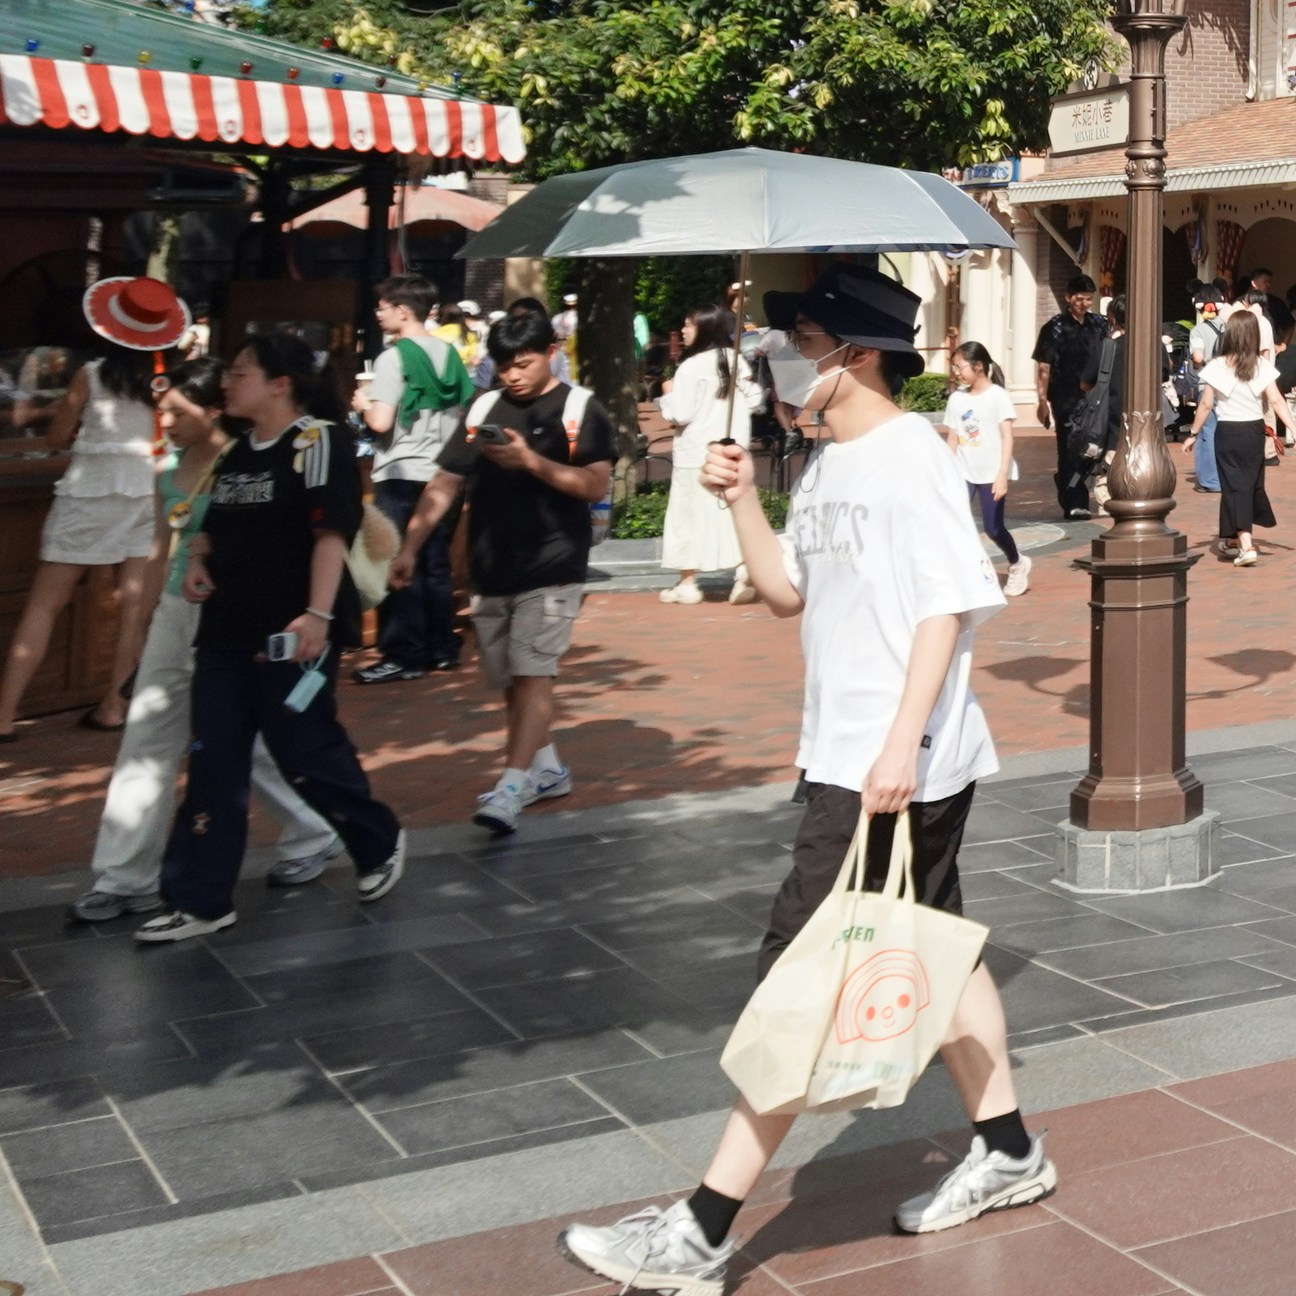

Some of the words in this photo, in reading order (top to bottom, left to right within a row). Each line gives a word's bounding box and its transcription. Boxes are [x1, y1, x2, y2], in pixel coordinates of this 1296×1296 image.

[1071, 99, 1113, 129] 米妮小巷
[1096, 127, 1110, 140] LANE
